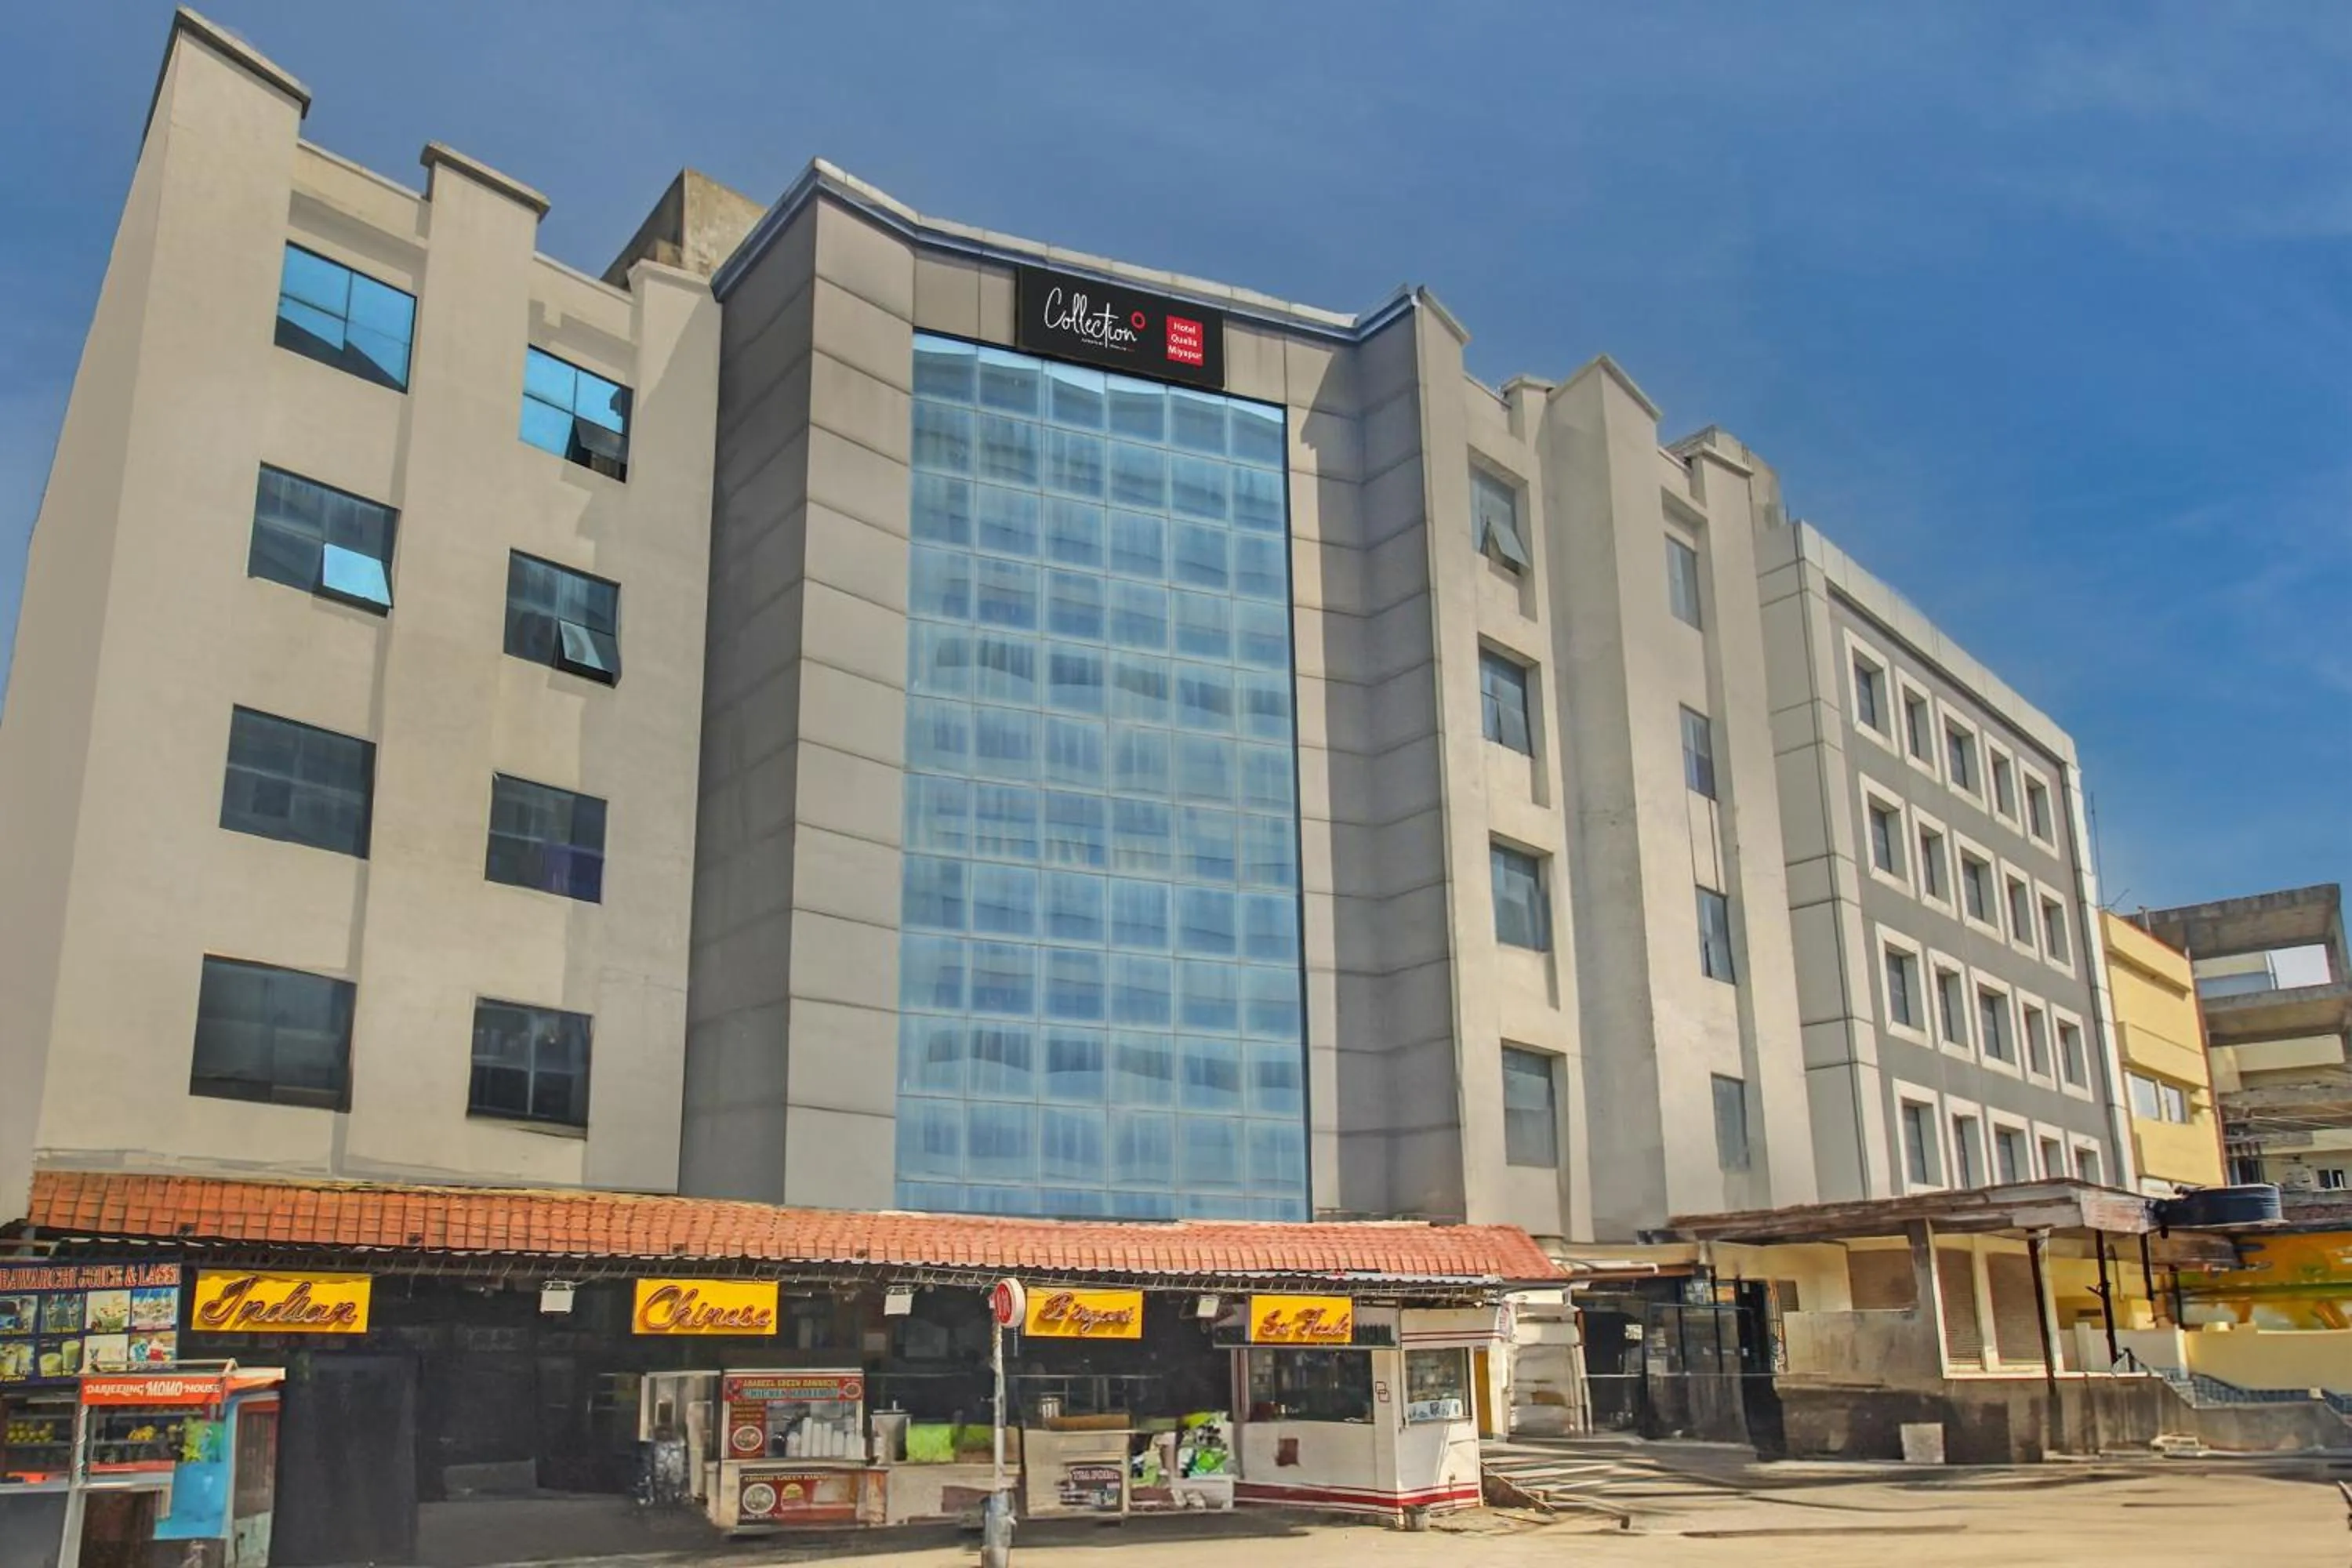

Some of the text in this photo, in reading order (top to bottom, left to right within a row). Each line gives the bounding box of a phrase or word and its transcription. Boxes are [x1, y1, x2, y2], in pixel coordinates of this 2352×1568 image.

[1044, 287, 1137, 348] Collection
[1174, 322, 1196, 335] Hotel
[125, 1264, 136, 1287] &
[201, 1275, 358, 1325] Indian
[640, 1285, 772, 1330] Chinese
[145, 1380, 183, 1396] MOMO
[183, 1383, 221, 1393] HOUSE
